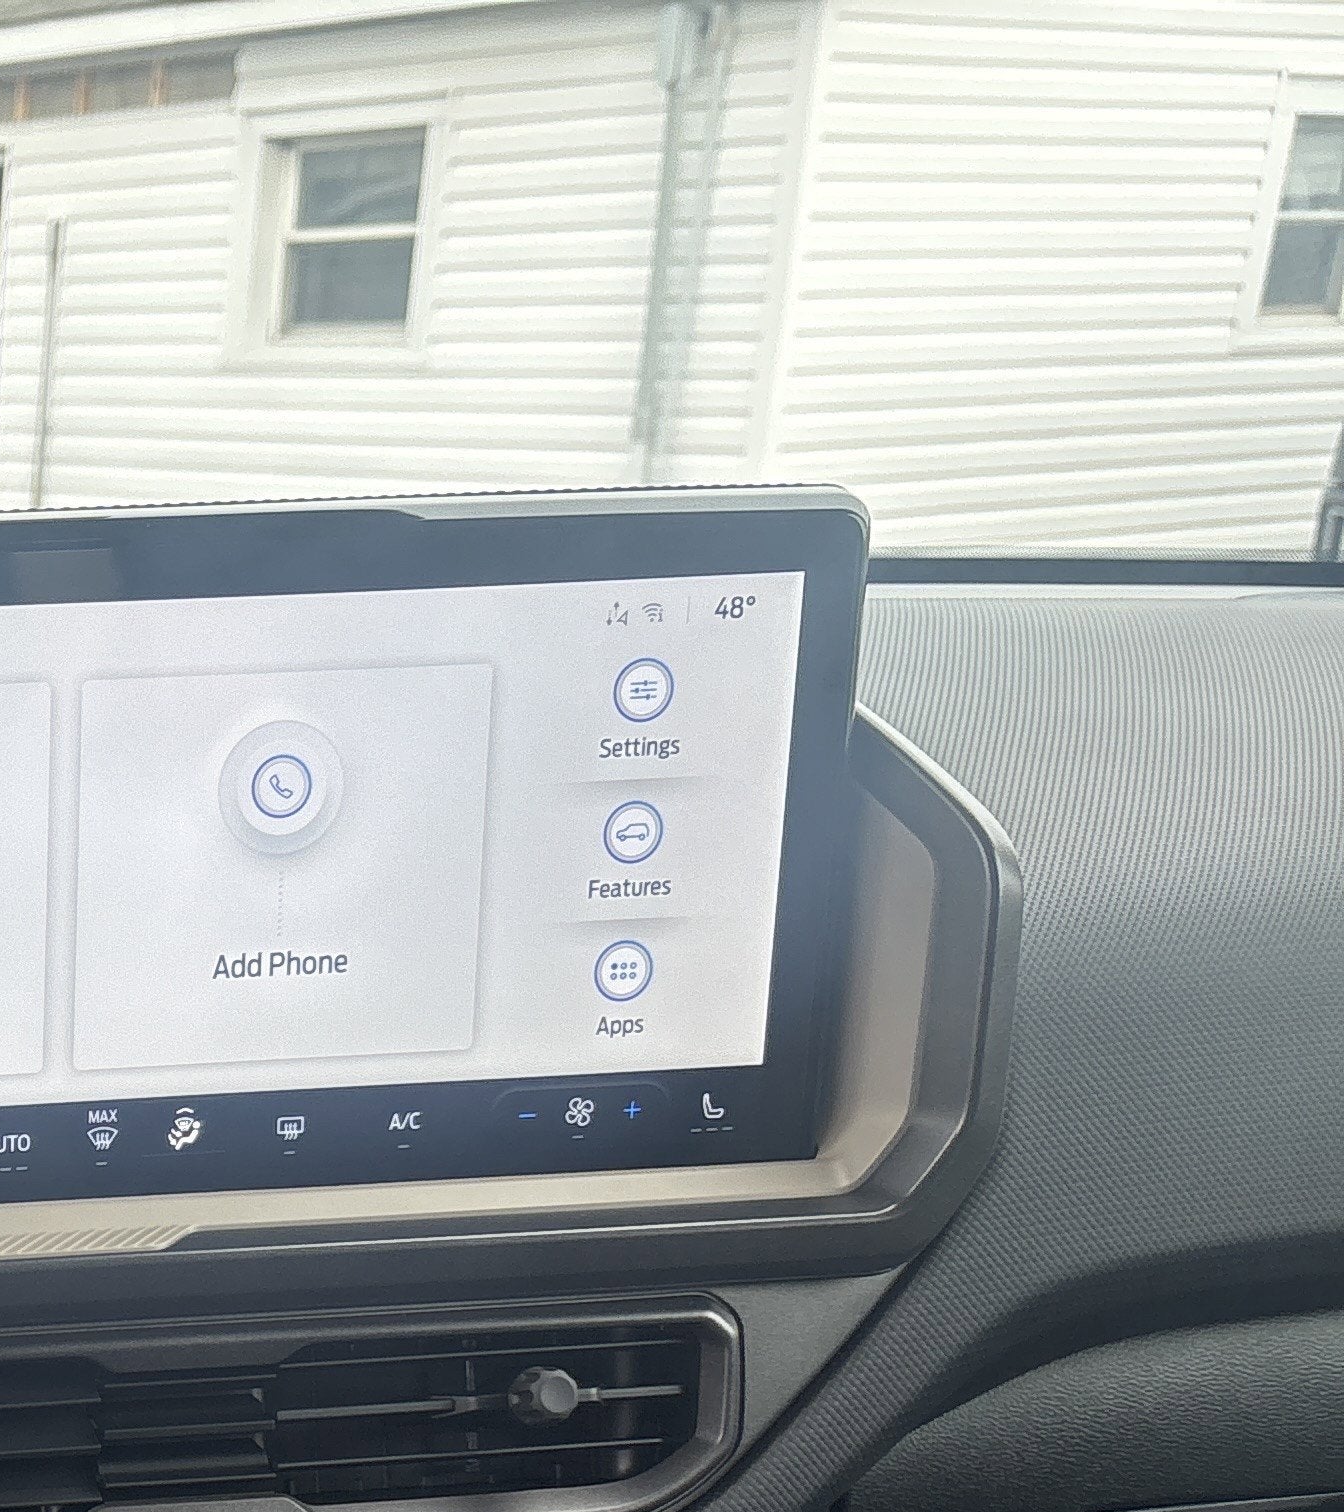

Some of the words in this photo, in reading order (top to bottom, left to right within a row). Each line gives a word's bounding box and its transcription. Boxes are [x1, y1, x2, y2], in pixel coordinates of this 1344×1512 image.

[714, 595, 756, 619] 48°
[599, 737, 680, 760] Settings
[588, 876, 672, 899] Features
[212, 954, 263, 980] Add
[268, 950, 349, 978] Phone
[596, 1014, 645, 1038] Apps
[88, 1109, 118, 1125] MAX
[388, 1110, 422, 1132] A/C
